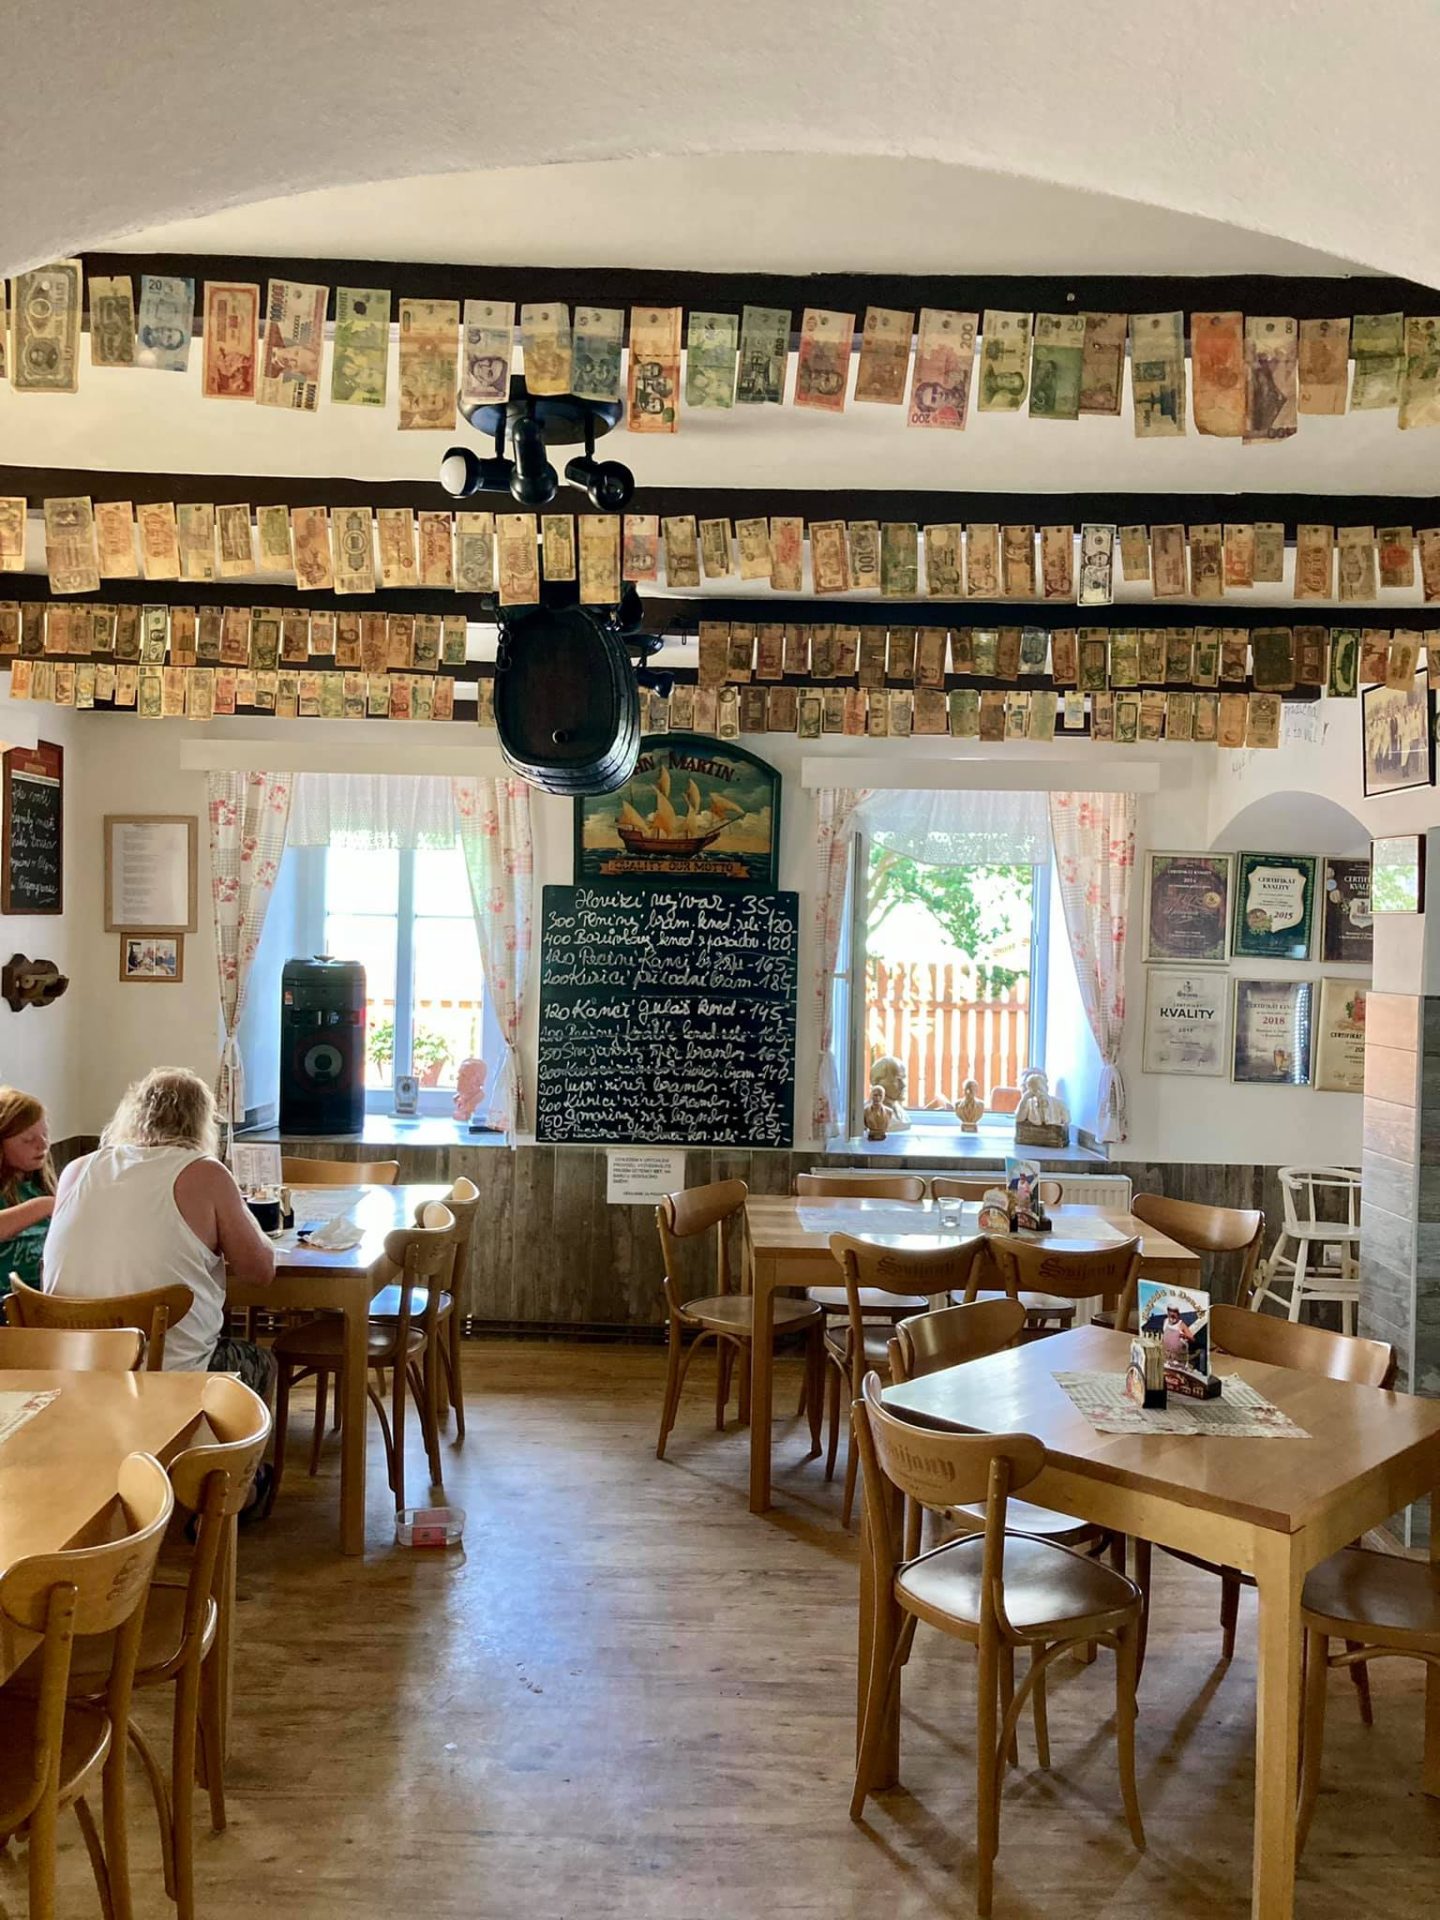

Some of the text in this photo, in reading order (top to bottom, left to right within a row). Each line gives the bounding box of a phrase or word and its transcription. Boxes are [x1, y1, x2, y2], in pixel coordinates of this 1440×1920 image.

[149, 279, 162, 290] 20
[1067, 318, 1084, 332] 20
[548, 911, 576, 930] 300
[1273, 911, 1294, 920] 2015
[543, 932, 571, 946] 400
[545, 948, 575, 965] 120
[544, 1003, 570, 1020] 120
[1160, 1007, 1215, 1020] KVALITY
[1262, 1016, 1286, 1025] 2018
[538, 1082, 563, 1096] 200
[538, 1097, 562, 1112] 200
